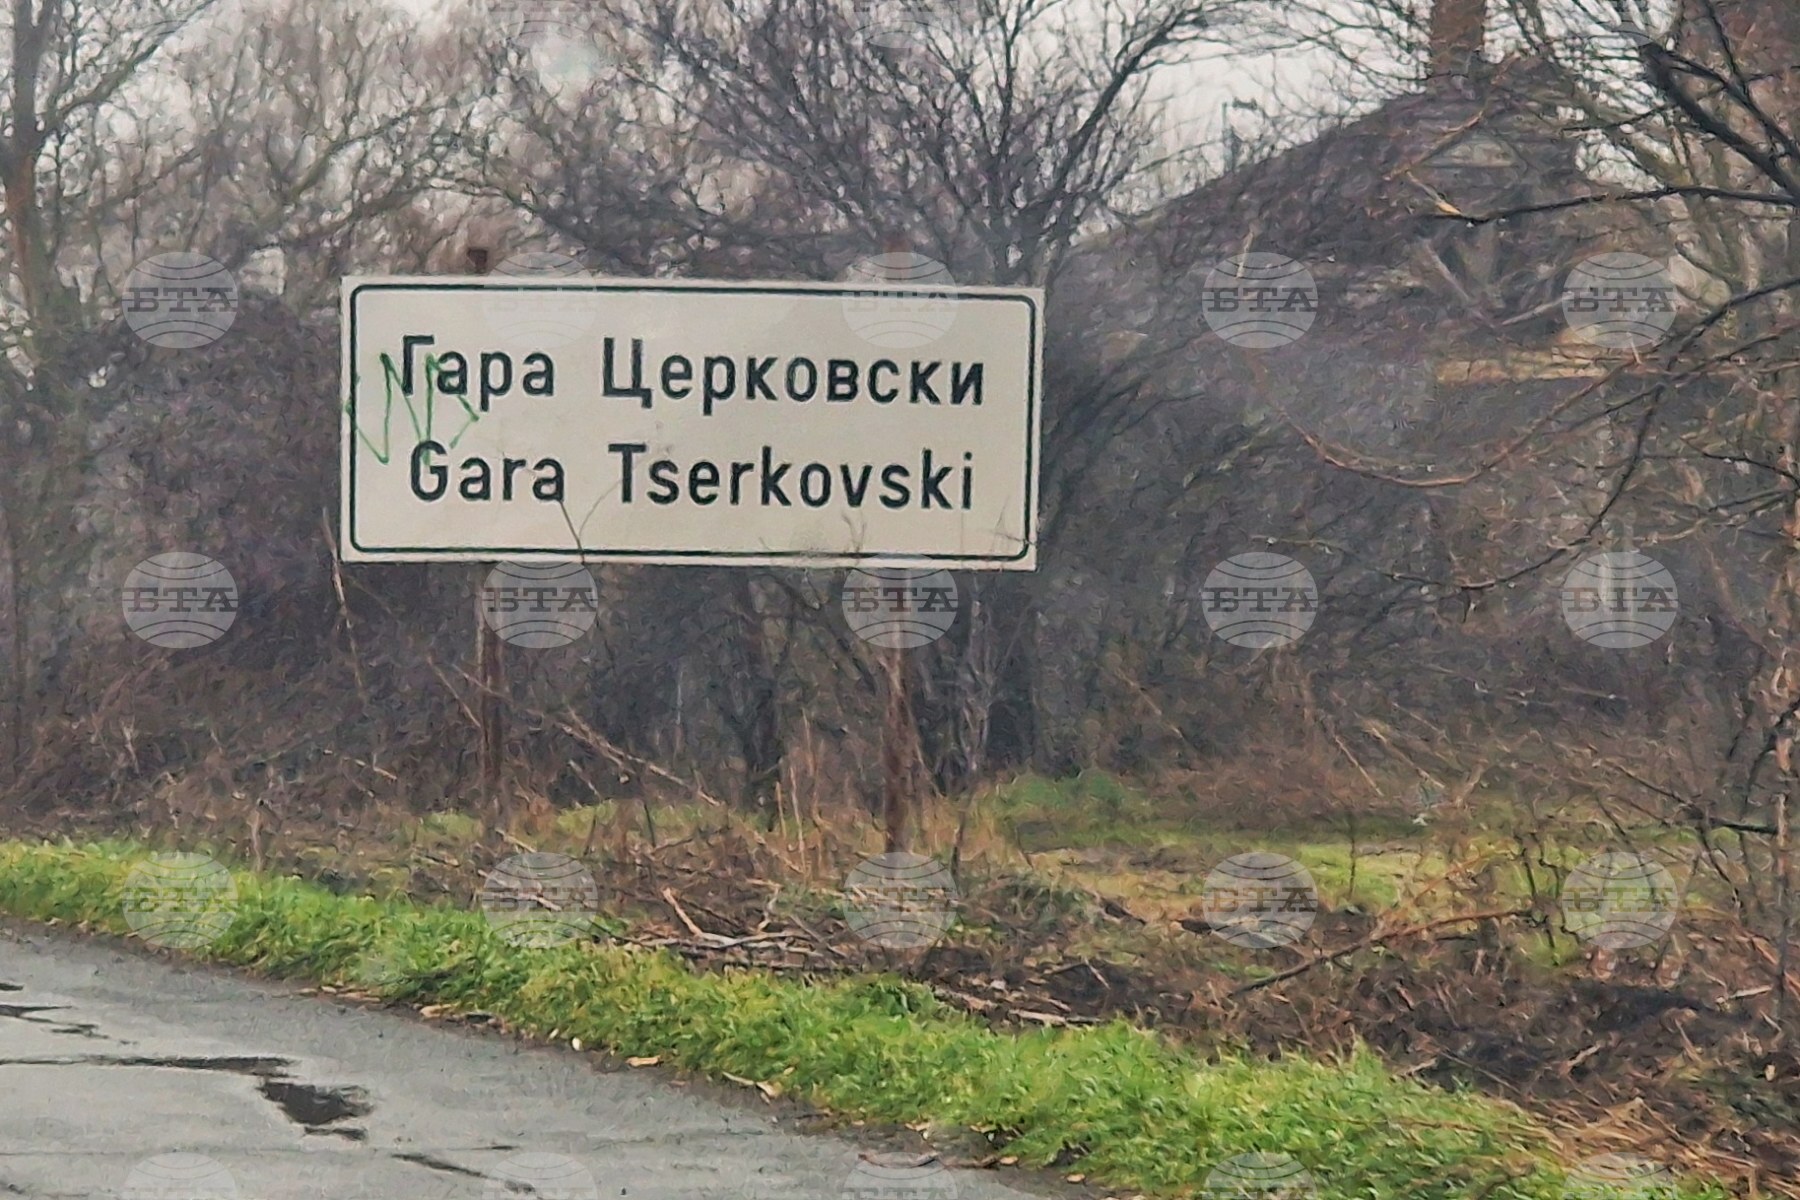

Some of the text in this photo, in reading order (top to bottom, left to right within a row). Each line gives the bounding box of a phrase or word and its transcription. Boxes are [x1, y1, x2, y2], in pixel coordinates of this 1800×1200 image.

[403, 335, 554, 413] Гара
[602, 337, 984, 416] Церковски
[410, 440, 972, 510] Gara Tserkovski
